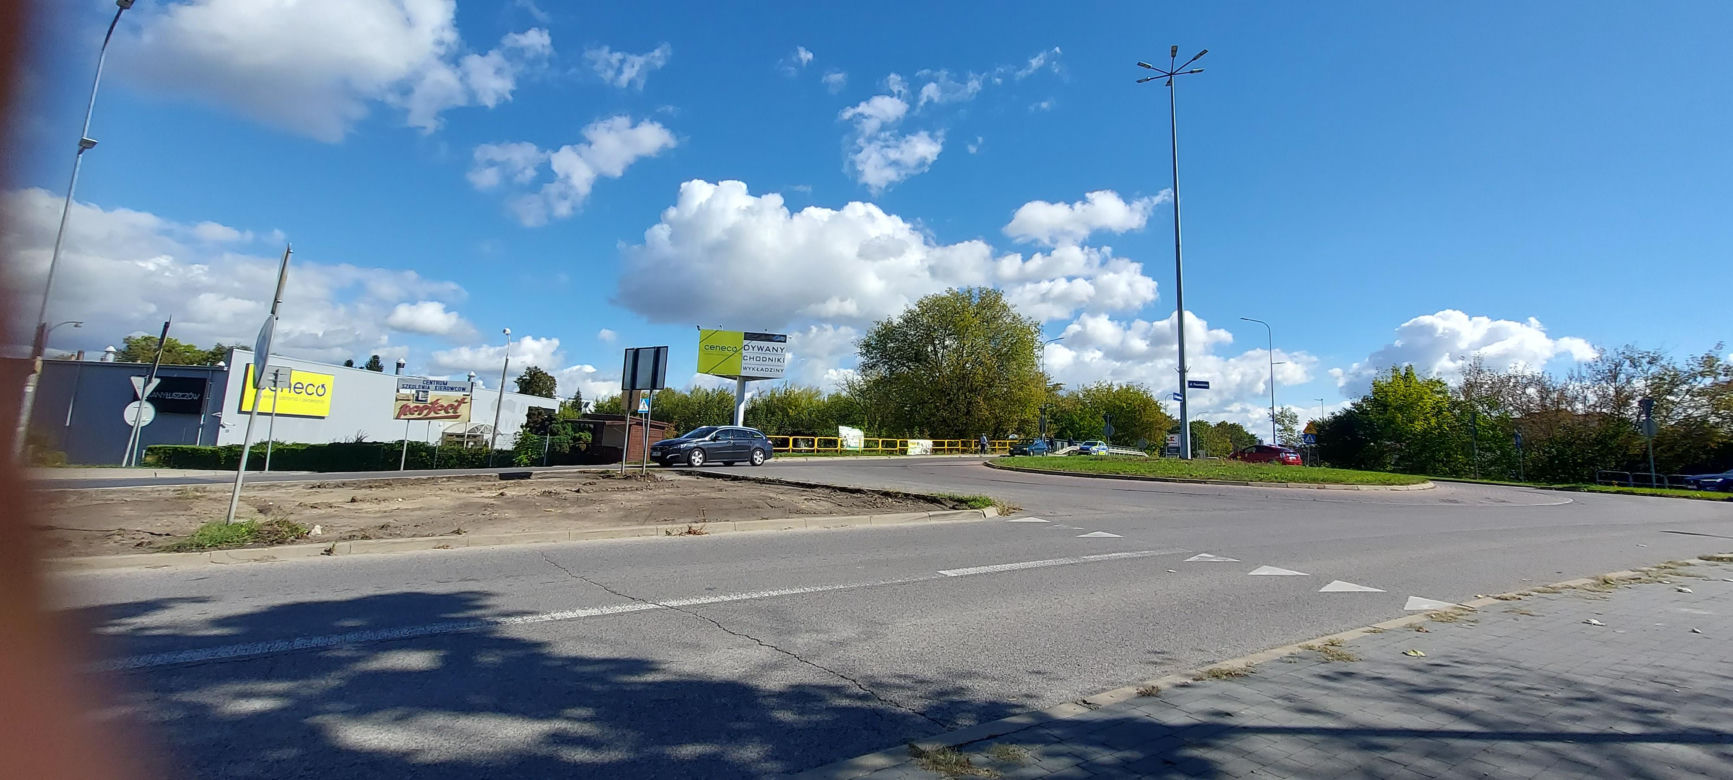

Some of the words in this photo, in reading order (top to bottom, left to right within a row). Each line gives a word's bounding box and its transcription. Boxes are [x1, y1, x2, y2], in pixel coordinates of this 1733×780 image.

[704, 344, 738, 353] ceneco
[743, 344, 785, 353] DYWANY
[742, 355, 785, 363] CHODNIKI
[260, 381, 326, 397] eco
[396, 397, 468, 418] perfect
